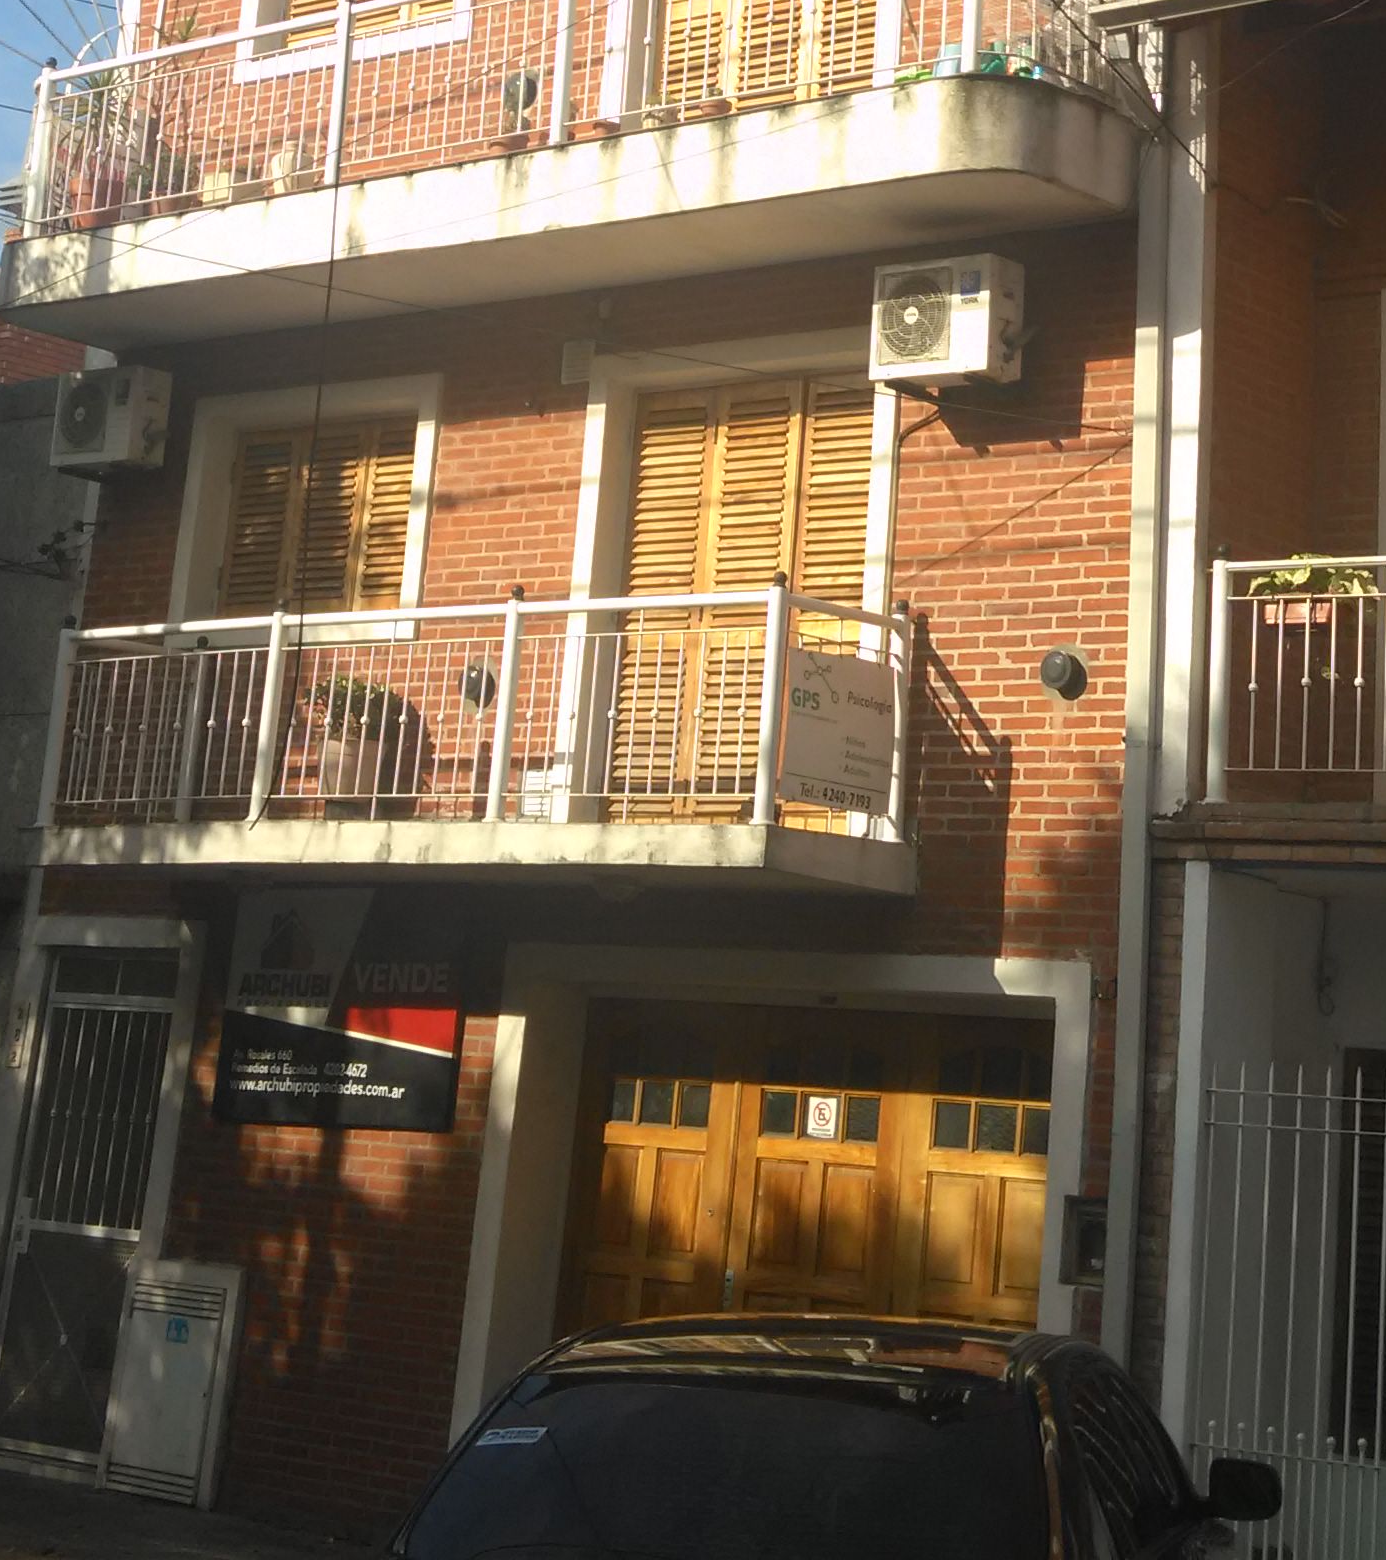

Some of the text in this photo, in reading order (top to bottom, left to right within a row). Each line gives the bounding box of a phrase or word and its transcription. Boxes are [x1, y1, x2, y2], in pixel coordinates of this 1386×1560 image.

[791, 687, 820, 711] GPS
[822, 787, 872, 810] 4240-7193
[238, 972, 332, 998] ARCHUBI
[353, 962, 451, 994] VENDE
[277, 1048, 293, 1061] 660
[230, 1061, 269, 1075] Remedios
[269, 1063, 281, 1075] de
[229, 1077, 406, 1100] www.archubipropiedades.com.ar
